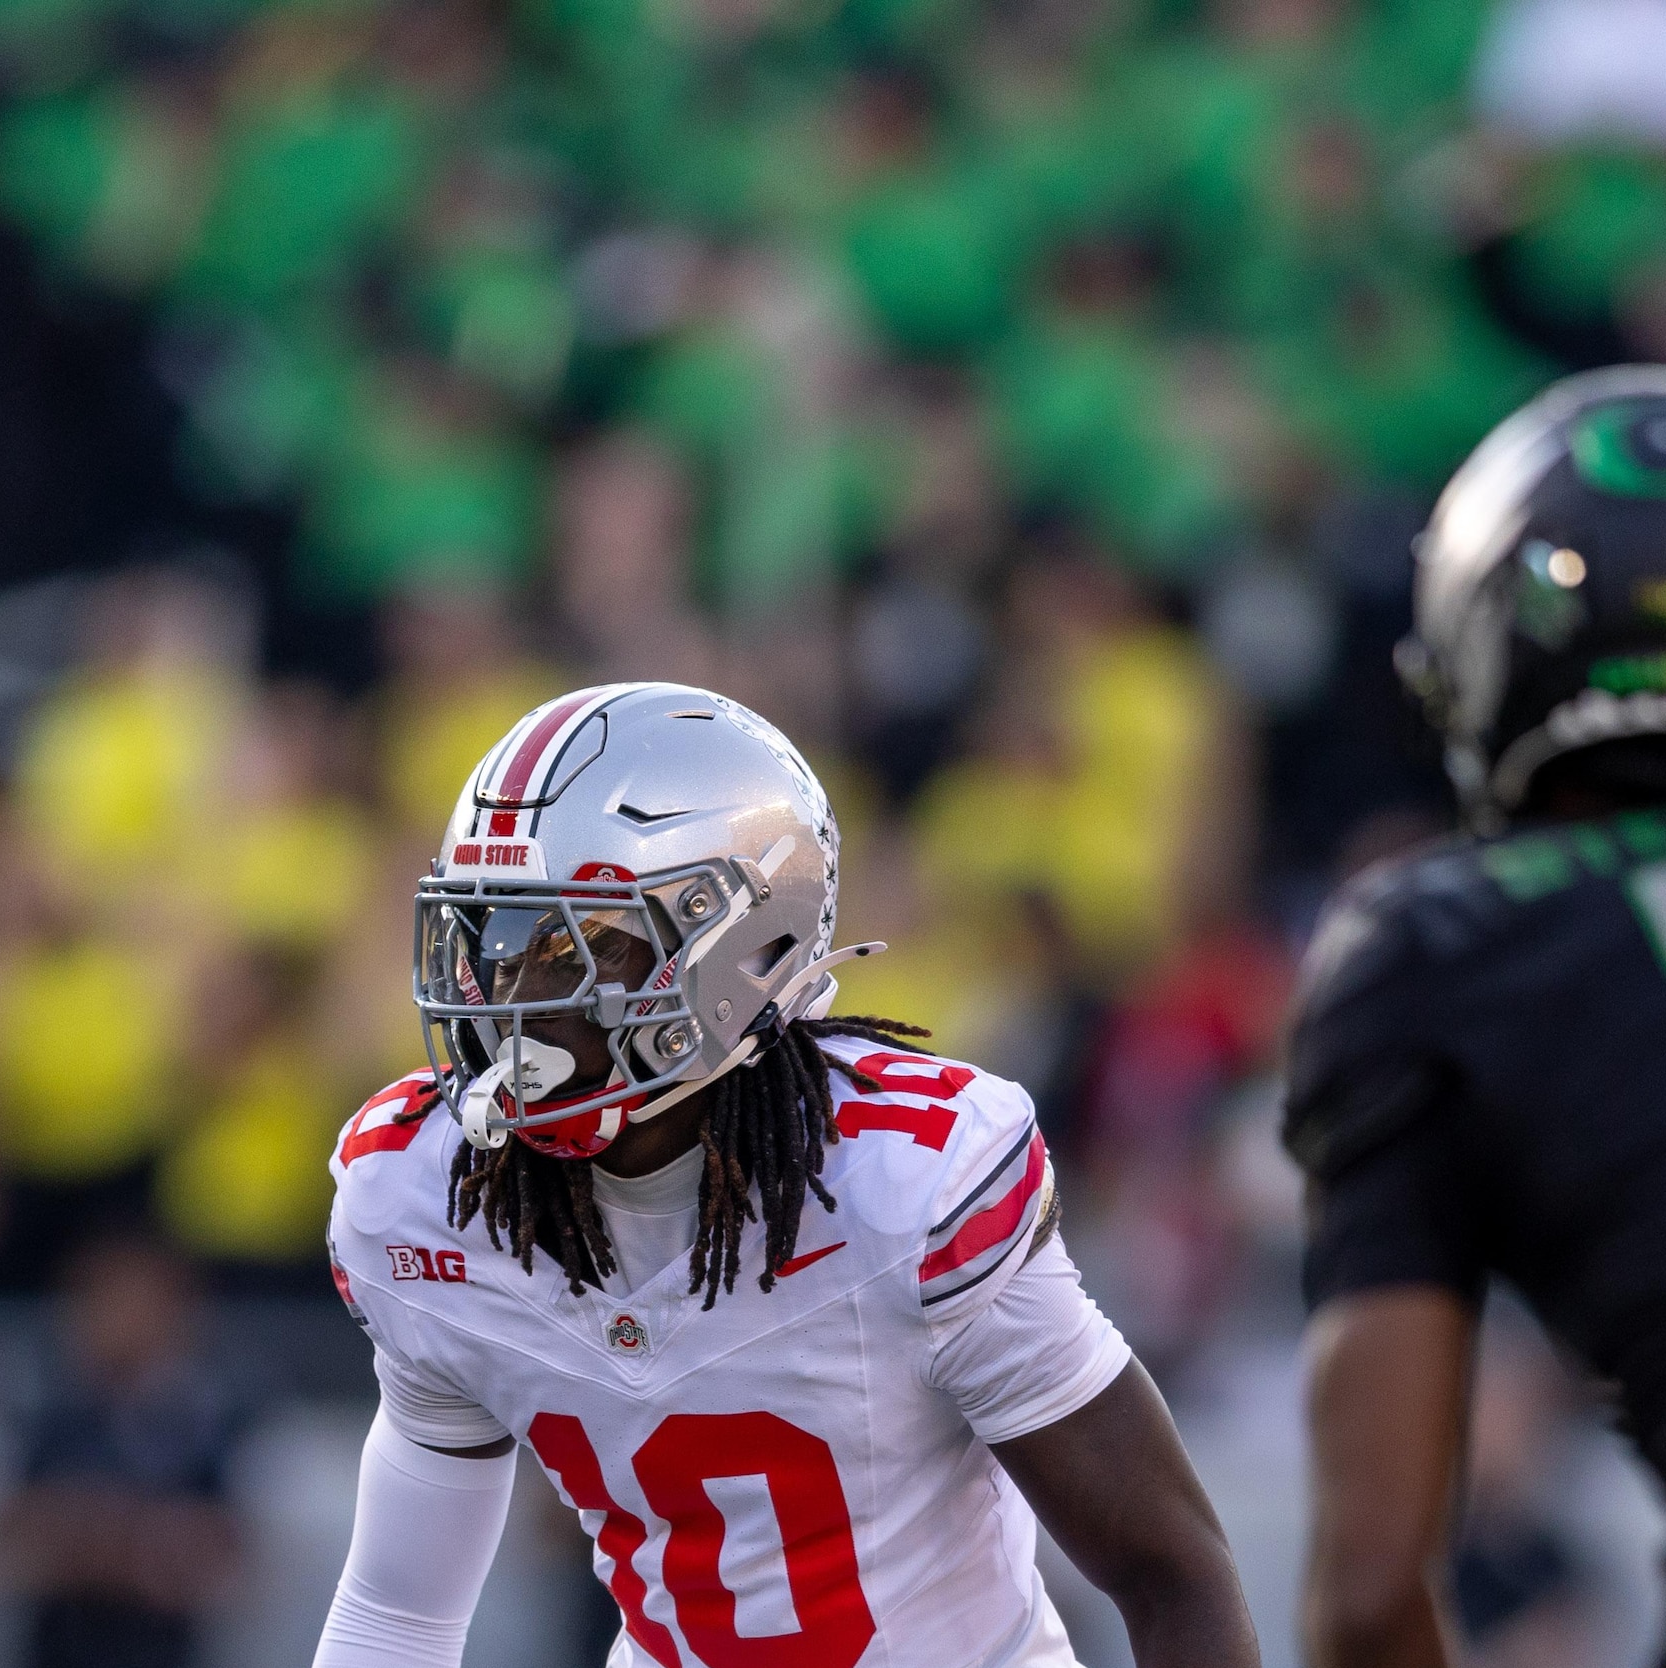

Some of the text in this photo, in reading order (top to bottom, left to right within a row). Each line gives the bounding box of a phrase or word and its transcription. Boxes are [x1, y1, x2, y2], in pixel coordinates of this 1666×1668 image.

[453, 844, 529, 866] OHIO STATE
[834, 1052, 977, 1153] 10
